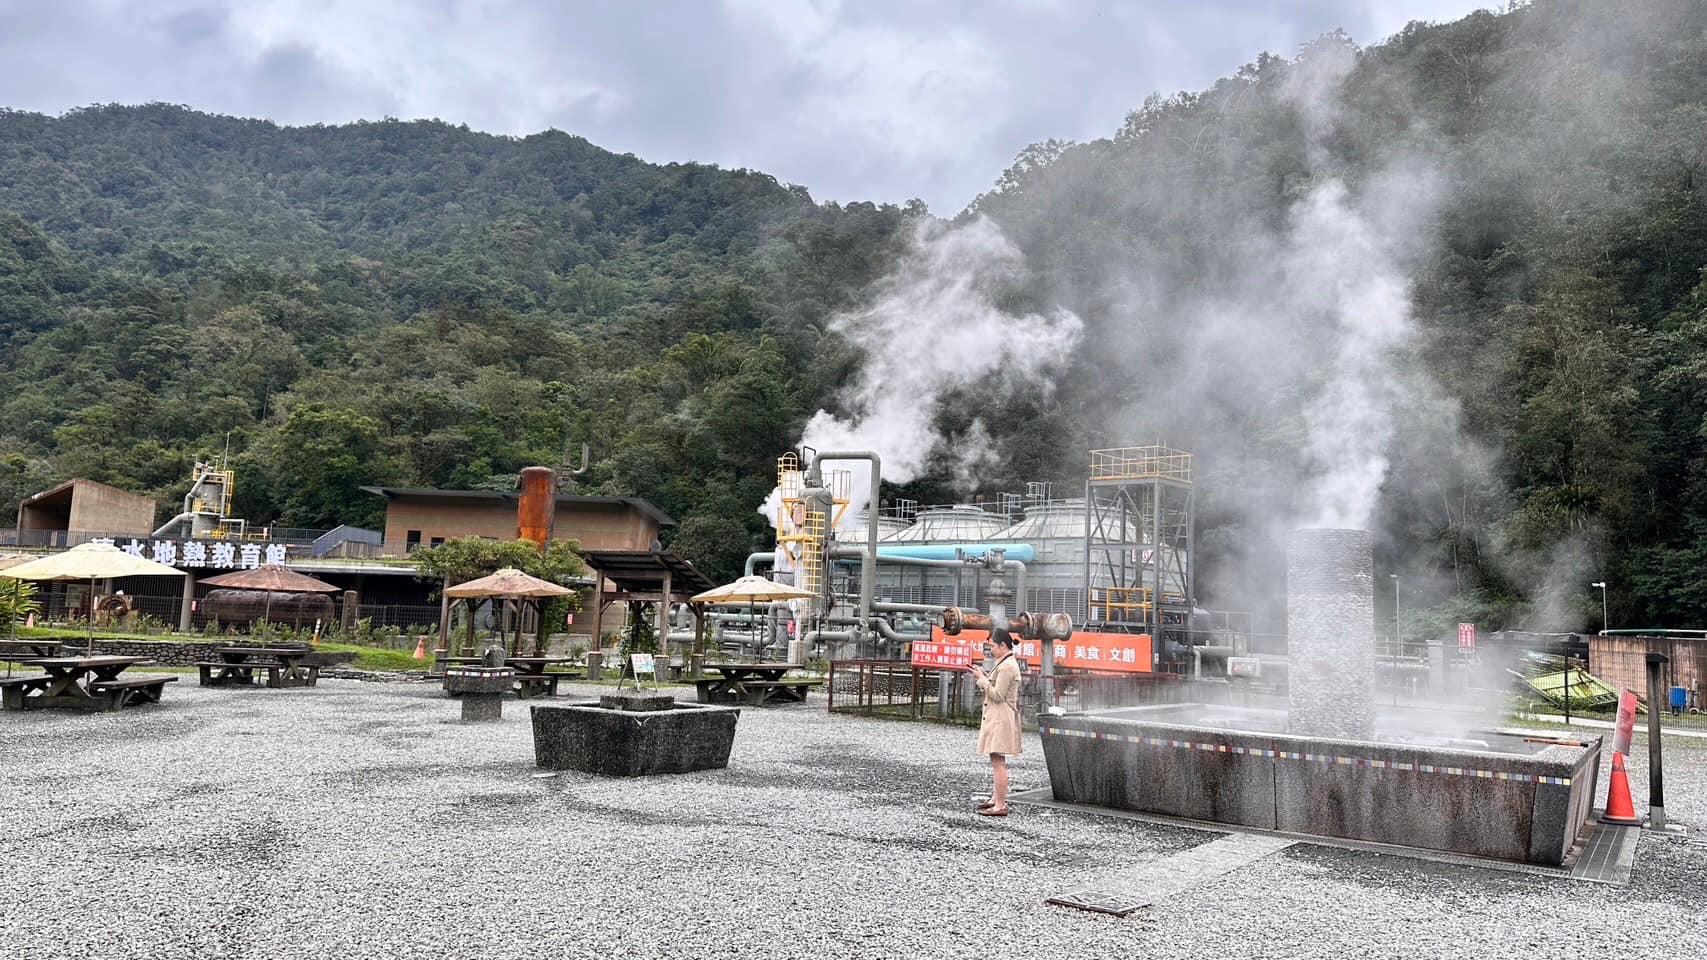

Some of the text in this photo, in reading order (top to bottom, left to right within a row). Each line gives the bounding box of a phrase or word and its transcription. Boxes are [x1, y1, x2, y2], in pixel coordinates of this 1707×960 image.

[92, 538, 286, 569] 水地熱教育館
[1074, 644, 1100, 660] 美食
[1109, 647, 1136, 662] 文創
